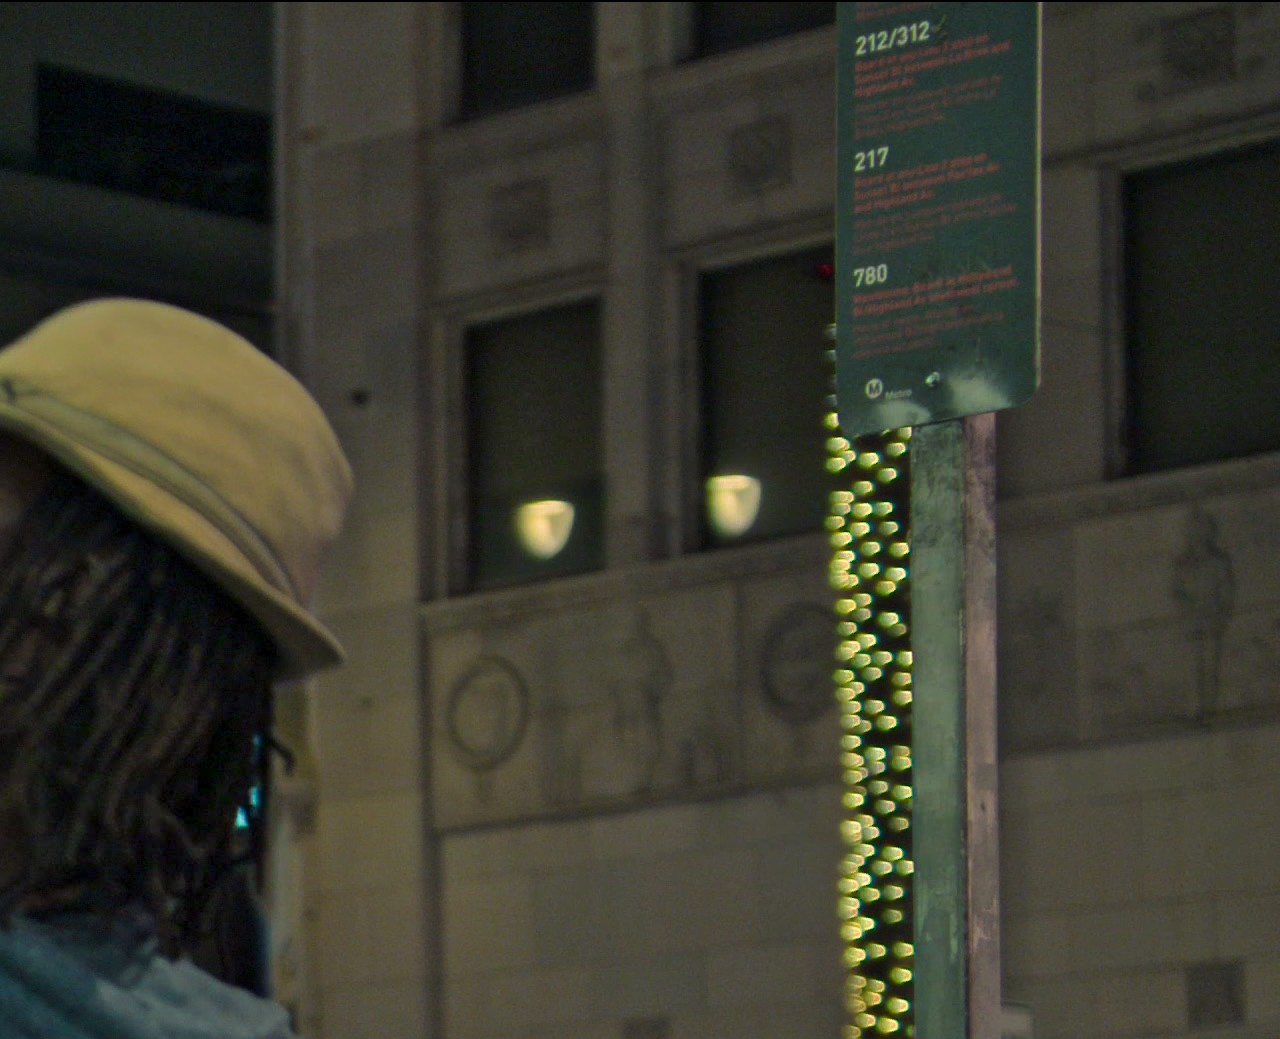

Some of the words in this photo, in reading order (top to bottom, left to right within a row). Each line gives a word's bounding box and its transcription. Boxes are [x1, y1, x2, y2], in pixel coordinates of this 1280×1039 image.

[855, 20, 931, 56] 212/312
[854, 146, 889, 172] 217
[853, 263, 888, 288] 780
